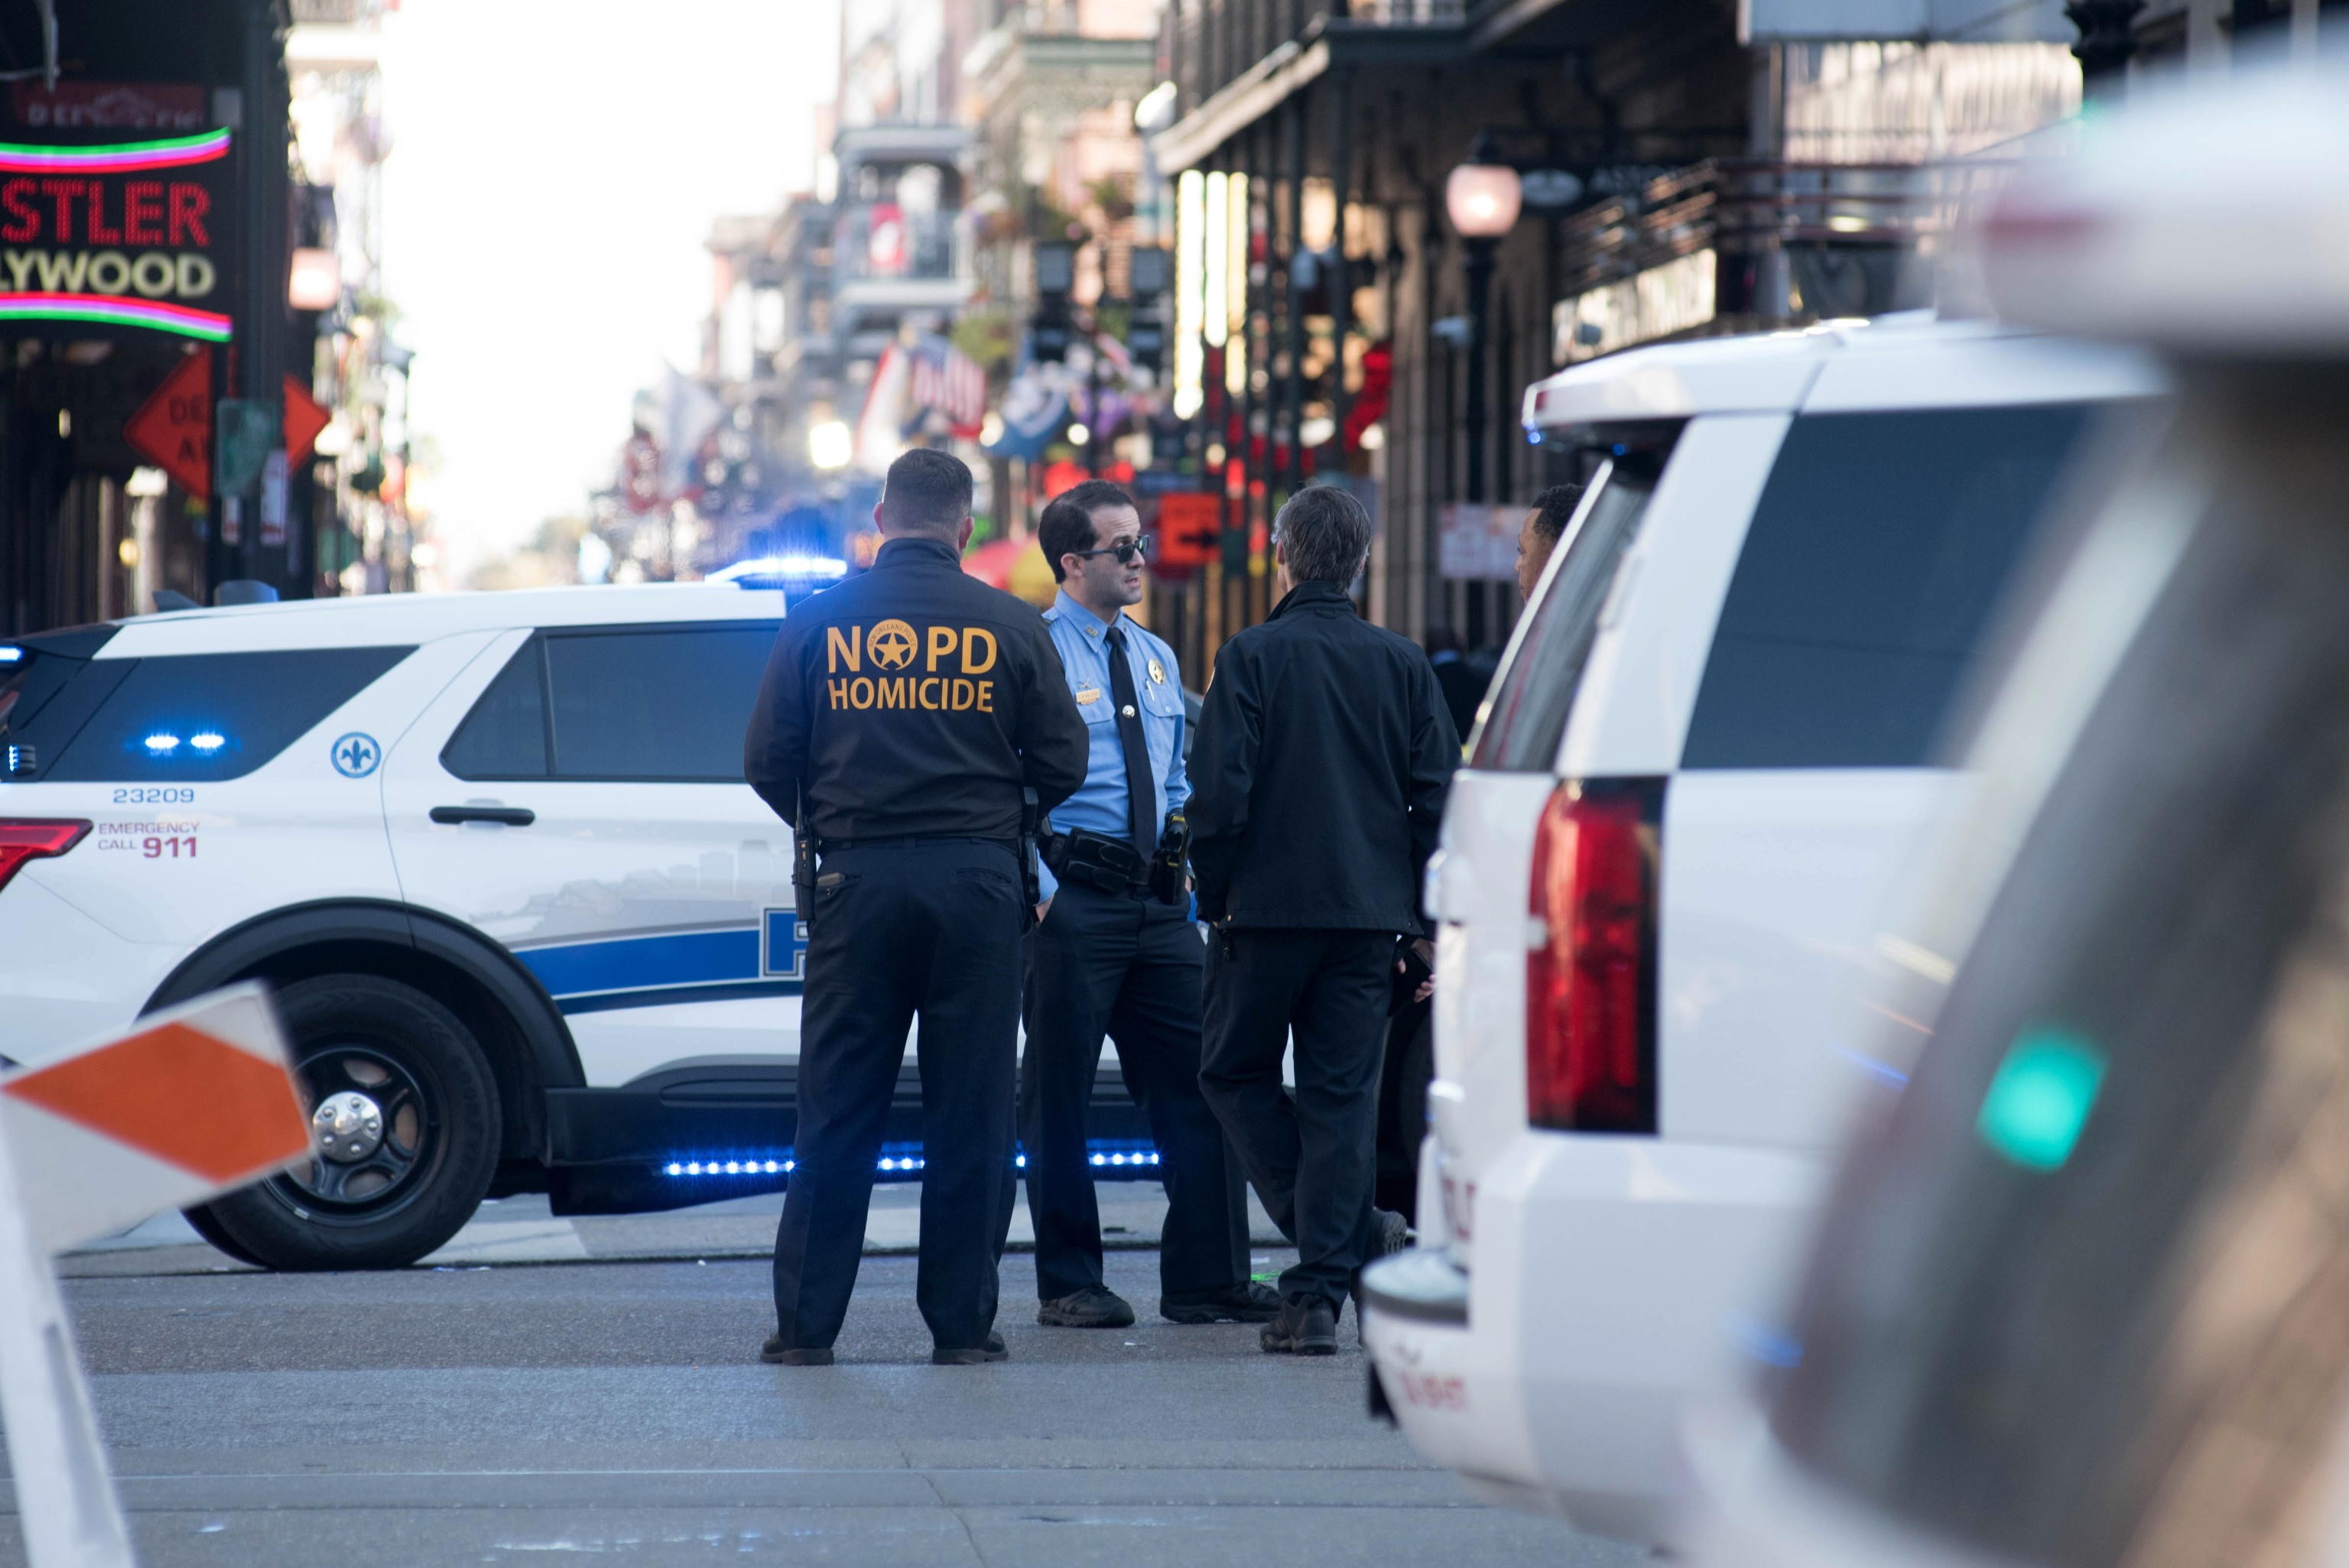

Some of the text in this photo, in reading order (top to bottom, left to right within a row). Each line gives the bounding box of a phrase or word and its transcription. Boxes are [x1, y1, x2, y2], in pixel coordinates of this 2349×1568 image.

[1, 177, 210, 247] STLER
[827, 677, 994, 713] HOMICIDE
[113, 788, 195, 803] 23209
[98, 823, 200, 835] EMERGENCY
[98, 836, 197, 858] CALL 911
